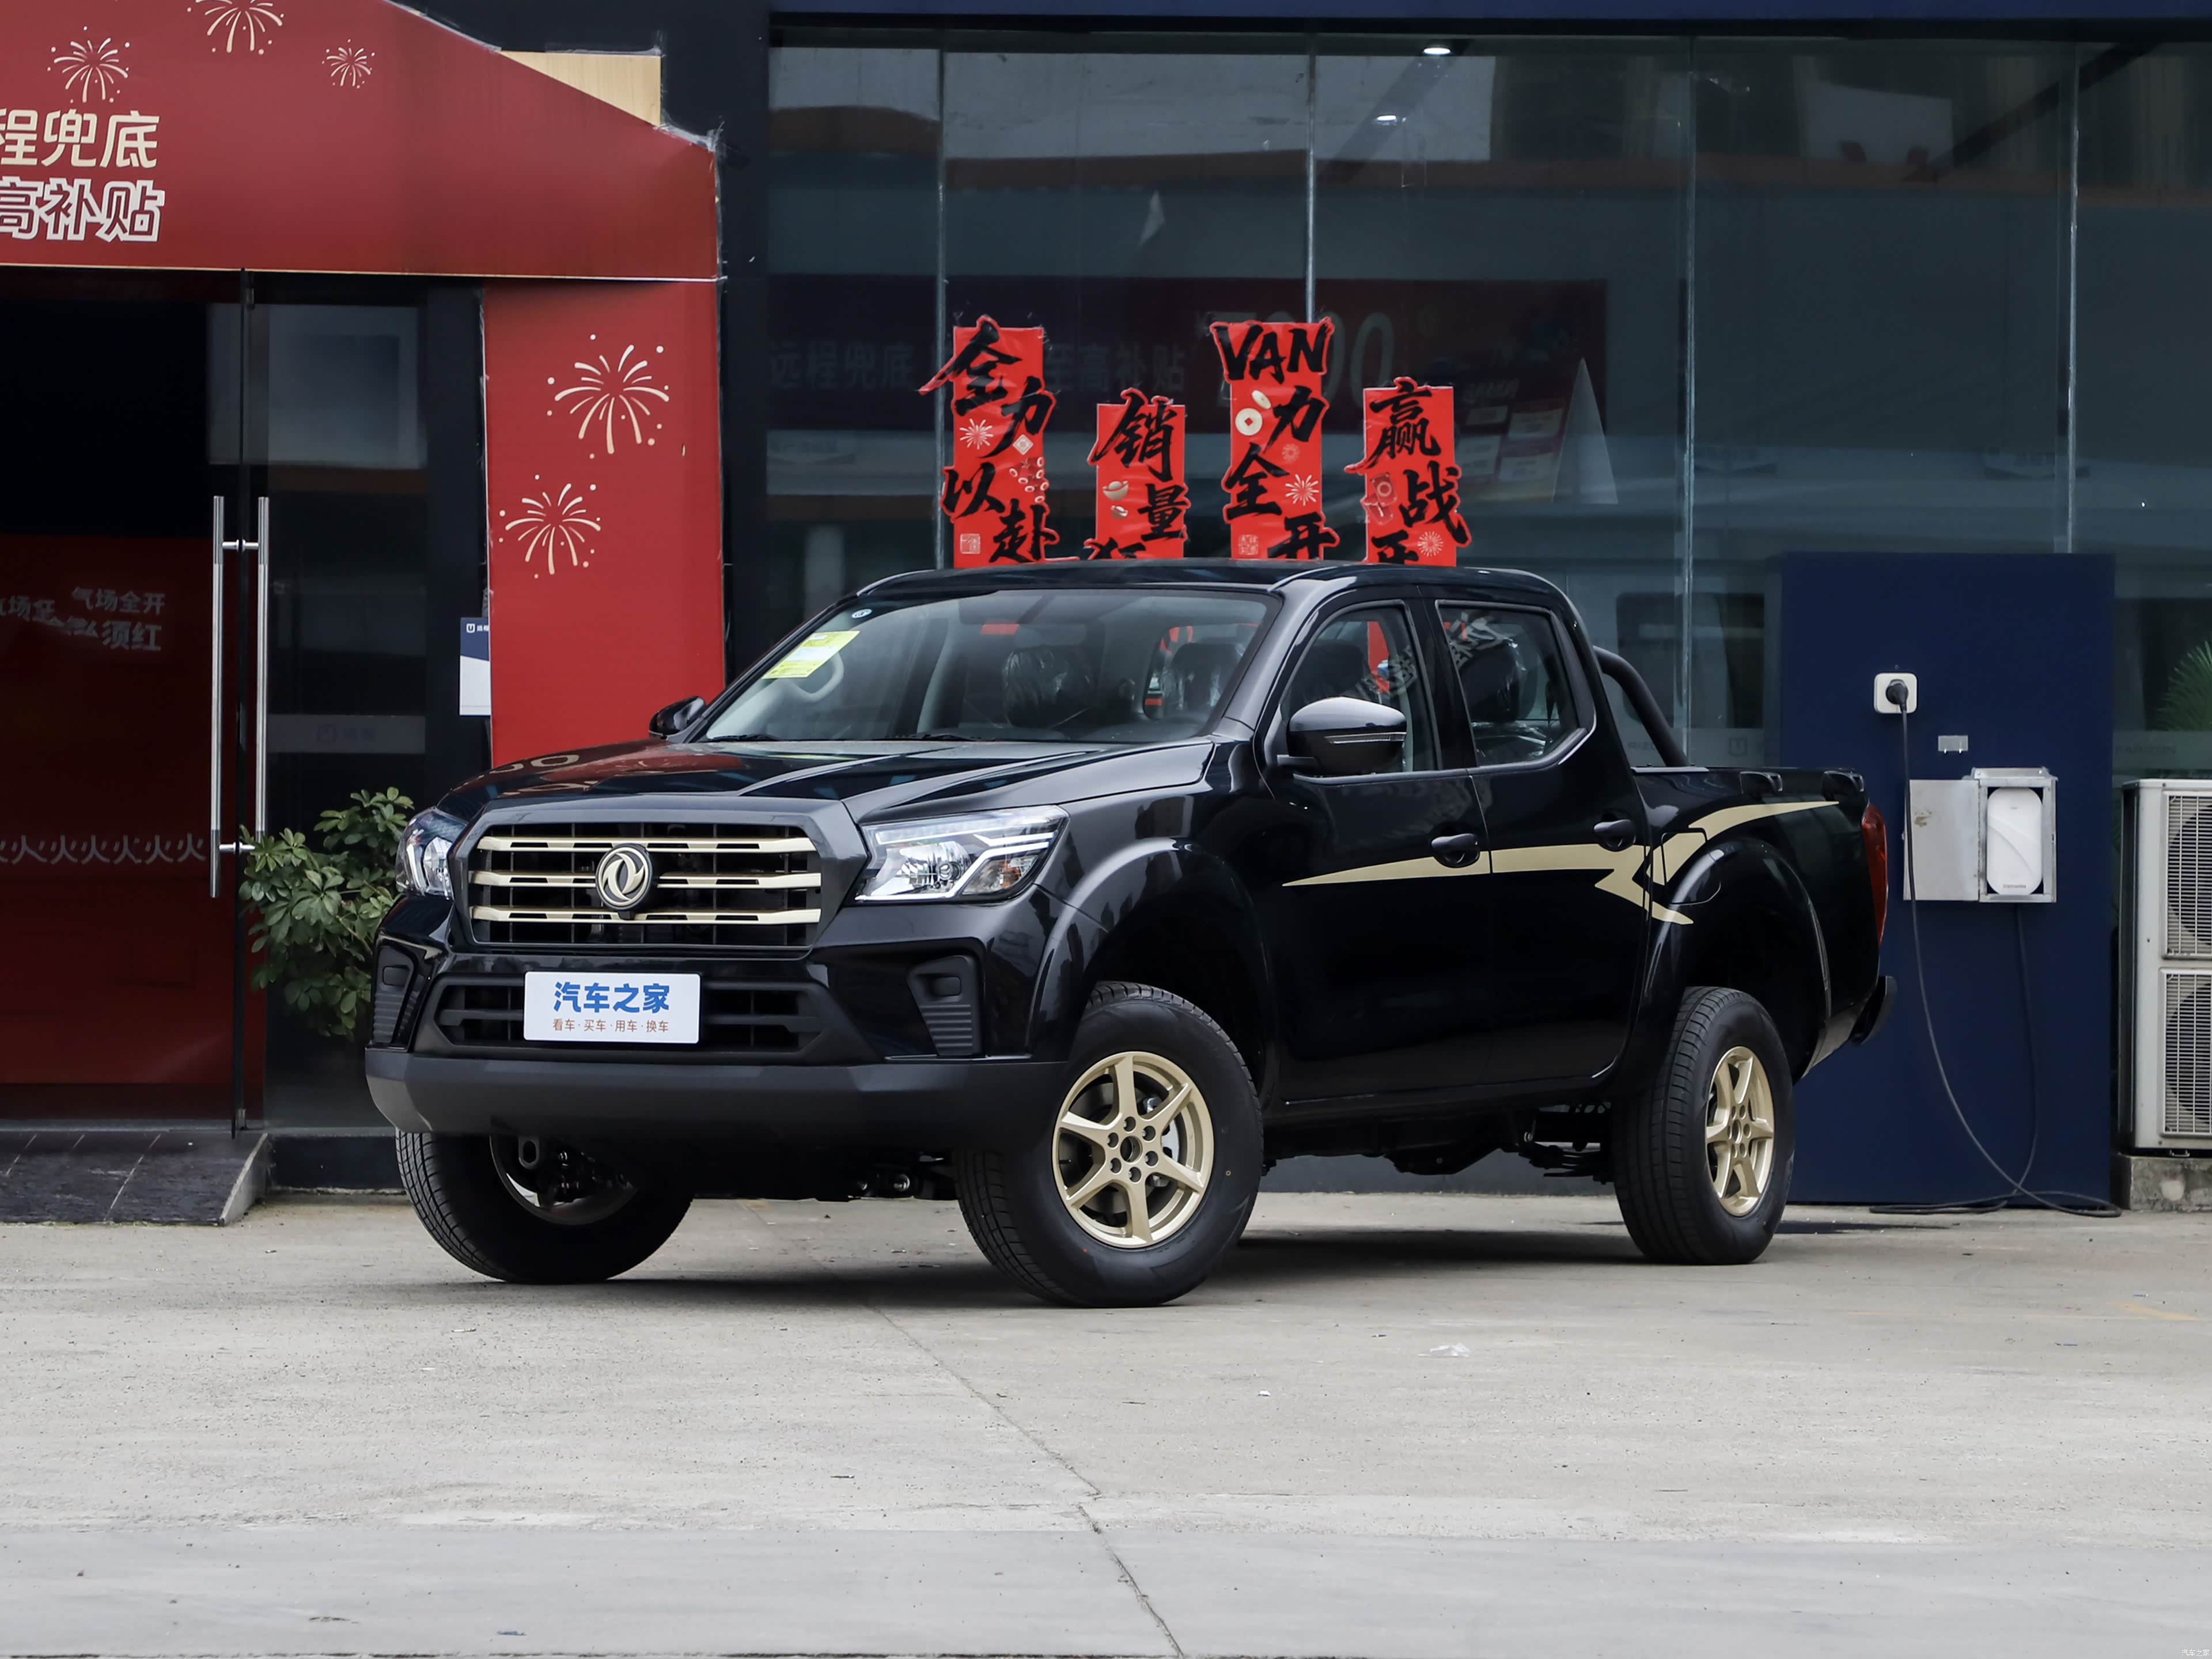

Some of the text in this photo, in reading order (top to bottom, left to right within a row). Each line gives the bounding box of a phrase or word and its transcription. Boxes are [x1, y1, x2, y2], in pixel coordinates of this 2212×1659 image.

[0, 108, 160, 168] 程兜底
[0, 176, 165, 242] 高补贴
[939, 320, 1059, 563] 全力以赴
[554, 982, 669, 1014] 汽车之家
